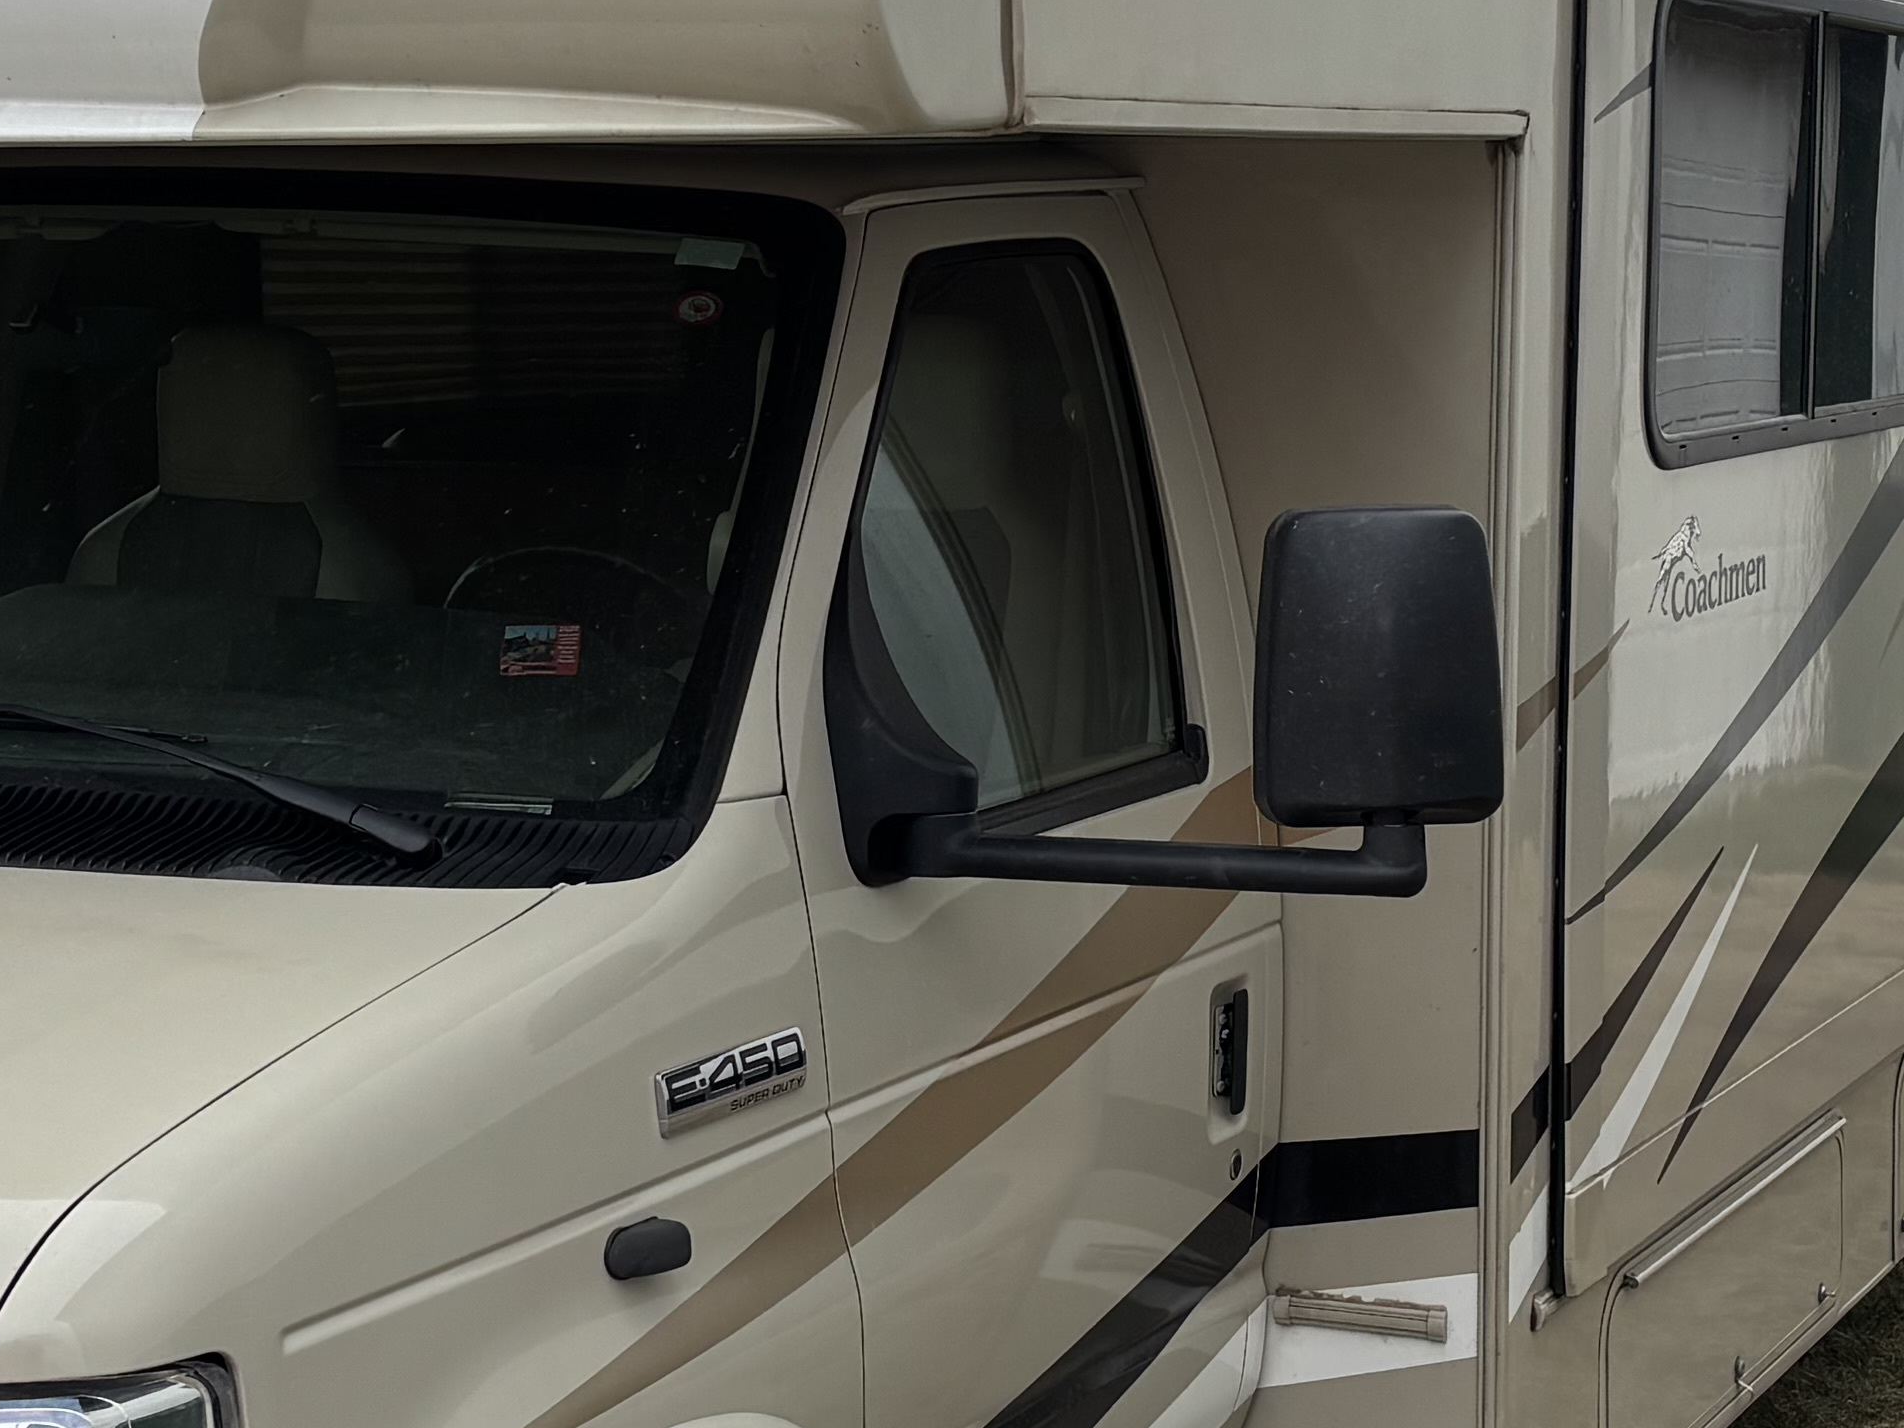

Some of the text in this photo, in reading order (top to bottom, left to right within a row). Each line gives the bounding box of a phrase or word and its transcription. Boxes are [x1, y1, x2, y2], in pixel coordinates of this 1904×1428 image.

[1671, 553, 1767, 622] Coachmen
[729, 1075, 806, 1112] SUPER DUTY
